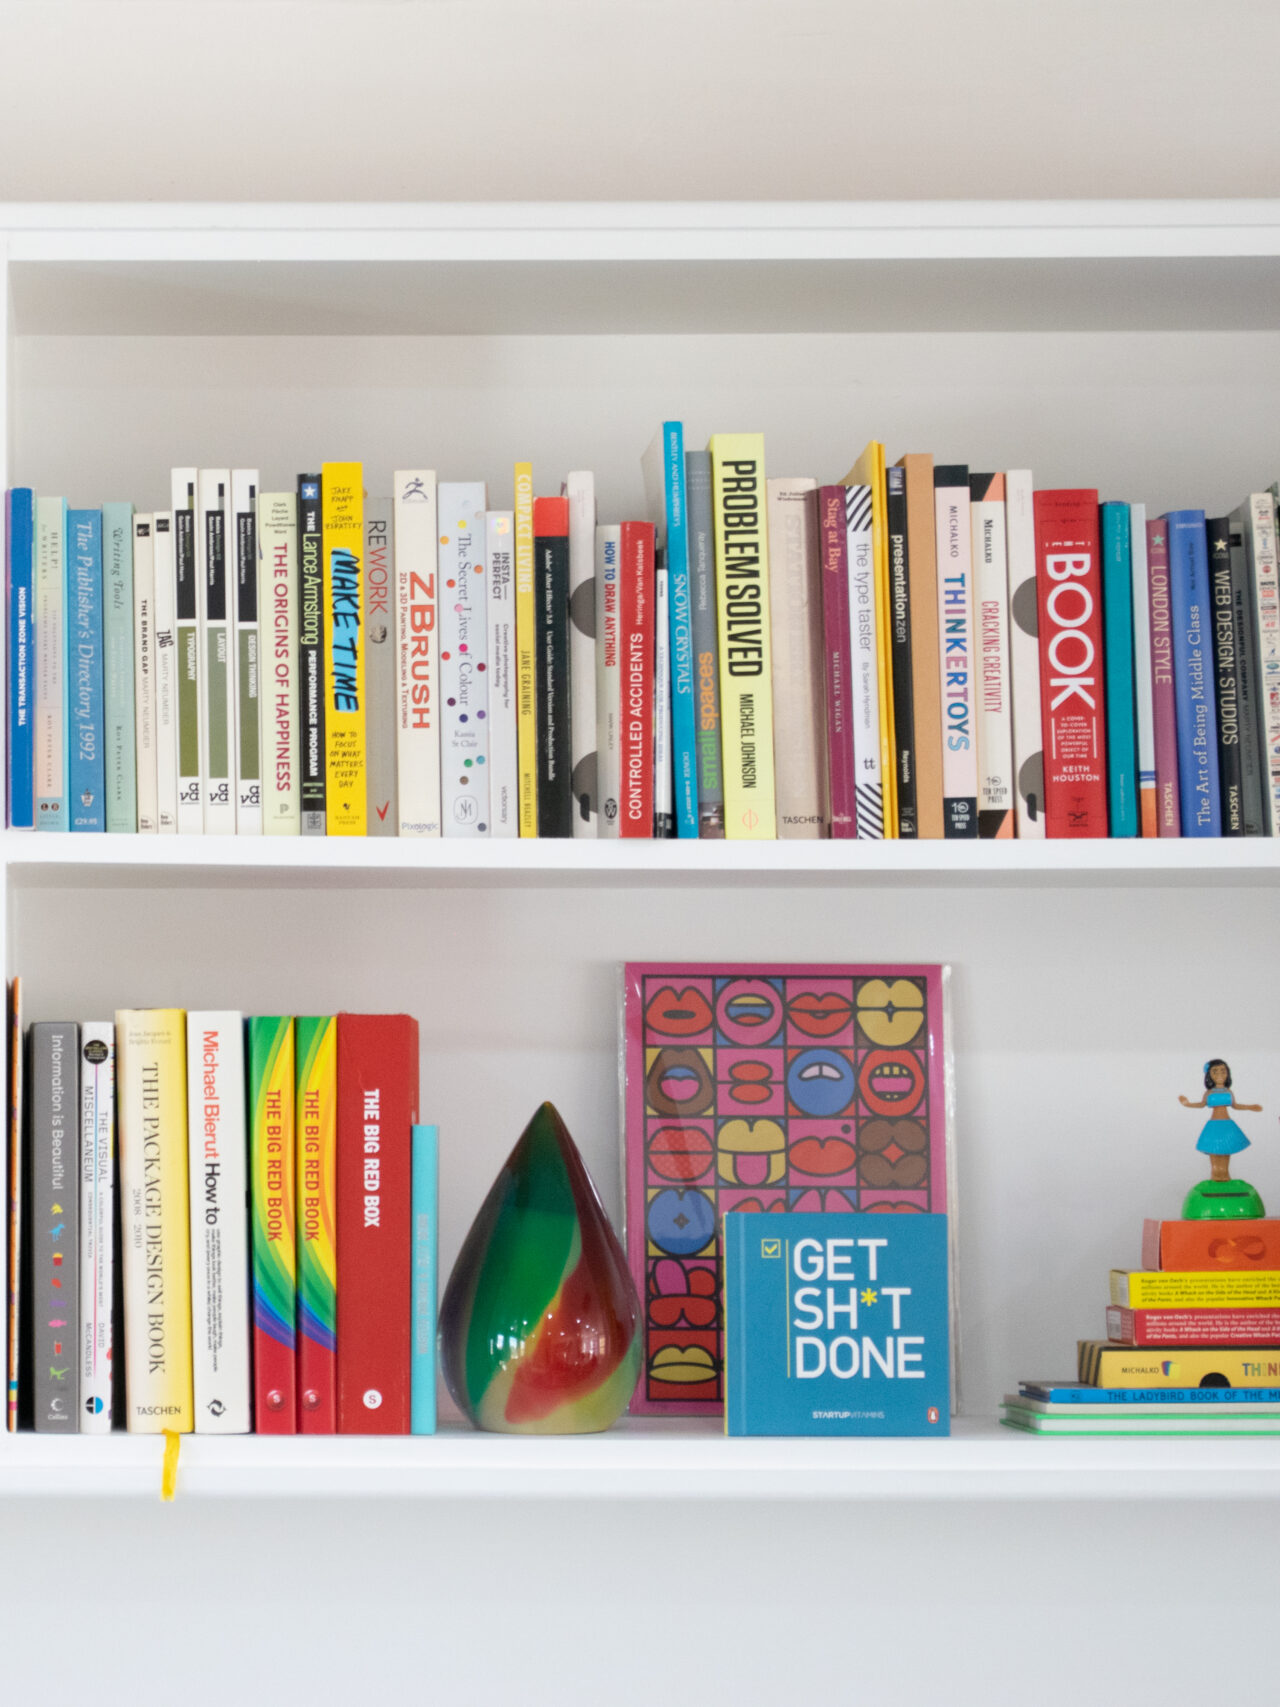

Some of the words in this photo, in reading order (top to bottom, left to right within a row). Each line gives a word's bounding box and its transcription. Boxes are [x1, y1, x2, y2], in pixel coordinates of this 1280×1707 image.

[307, 511, 316, 532] THE
[722, 460, 760, 579] PROBLEM
[824, 498, 843, 529] Stag
[949, 505, 959, 558] MICHALKO
[76, 521, 94, 552] The
[302, 533, 323, 574] Lance
[458, 533, 472, 558] The
[828, 530, 839, 544] at
[856, 543, 870, 567] the
[274, 542, 288, 578] THE
[367, 520, 388, 615] REWORK
[458, 561, 475, 601] Secret
[824, 547, 842, 573] Bay
[18, 586, 27, 618] VISION
[76, 555, 95, 639] Publisher's
[300, 574, 322, 645] Armstrong
[331, 550, 361, 628] MAKE
[673, 574, 687, 624] SNOW
[854, 572, 871, 604] type
[891, 534, 908, 643] presentationzen
[1150, 565, 1170, 632] LONDON
[1215, 569, 1232, 606] WEB
[18, 618, 27, 644] ZONE
[274, 583, 290, 659] ORIGINS
[456, 603, 473, 641] Lives
[725, 584, 764, 677] SOLVED
[858, 610, 872, 652] taster
[981, 600, 1001, 653] CRACKING
[1045, 553, 1096, 711] BOOK
[1187, 602, 1201, 647] Class
[1216, 610, 1235, 672] DESIGN:
[18, 644, 27, 708] TRANSACTION
[76, 644, 95, 719] Directory
[275, 663, 290, 688] OF
[331, 637, 359, 711] TIME
[629, 632, 644, 718] ACCIDENTS
[675, 625, 691, 694] CRYSTALS
[944, 572, 970, 751] THINKERTOYS
[1153, 633, 1172, 687] STYLE
[1188, 646, 1205, 700] Middle
[308, 649, 318, 725] PERFORMANCE
[458, 662, 473, 706] Colour
[982, 655, 1002, 713] CREATIVITY
[18, 708, 27, 727] THE
[739, 693, 755, 739] MICHAEL
[1191, 698, 1209, 750] Being
[1219, 676, 1239, 745] STUDIOS
[79, 723, 96, 761] 1992
[275, 693, 291, 792] HAPPINESS
[309, 727, 319, 777] PROGRAM
[1193, 750, 1208, 770] of
[628, 720, 643, 820] CONTROLLED
[740, 741, 757, 789] JOHNSON
[1196, 769, 1210, 794] Art
[783, 816, 824, 824] TASCHEN
[1164, 781, 1175, 827] TASCHEN
[1196, 797, 1211, 826] The
[1229, 784, 1240, 830] TASCHEN
[142, 1062, 160, 1109] THE
[203, 1031, 220, 1100] Michael
[98, 1111, 108, 1135] THE
[265, 1089, 282, 1120] THE
[304, 1087, 320, 1120] THE
[363, 1088, 380, 1121] THE
[83, 1086, 94, 1183] MISCELLANEUM
[204, 1104, 220, 1159] Bierut
[267, 1125, 283, 1153] BIG
[305, 1125, 321, 1153] BIG
[363, 1124, 381, 1154] BIG
[98, 1138, 108, 1183] VISUAL
[143, 1117, 162, 1217] PACKAGE
[204, 1162, 221, 1204] How
[267, 1159, 283, 1191] RED
[302, 1159, 321, 1197] RED
[363, 1158, 380, 1192] RED
[205, 1206, 221, 1226] to
[265, 1197, 284, 1245] BOOK
[303, 1197, 322, 1245] BOOK
[364, 1195, 380, 1228] BOX
[146, 1225, 164, 1305] DESIGN
[793, 1238, 888, 1282] GET
[148, 1313, 166, 1374] BOOK
[795, 1335, 926, 1379] DONE
[1121, 1367, 1160, 1375] MICHALKO
[136, 1406, 181, 1415] TASCHEN
[1107, 1392, 1127, 1401] THE
[1190, 1391, 1219, 1400] BOOK
[1224, 1391, 1238, 1400] OF
[1243, 1391, 1264, 1400] THE
